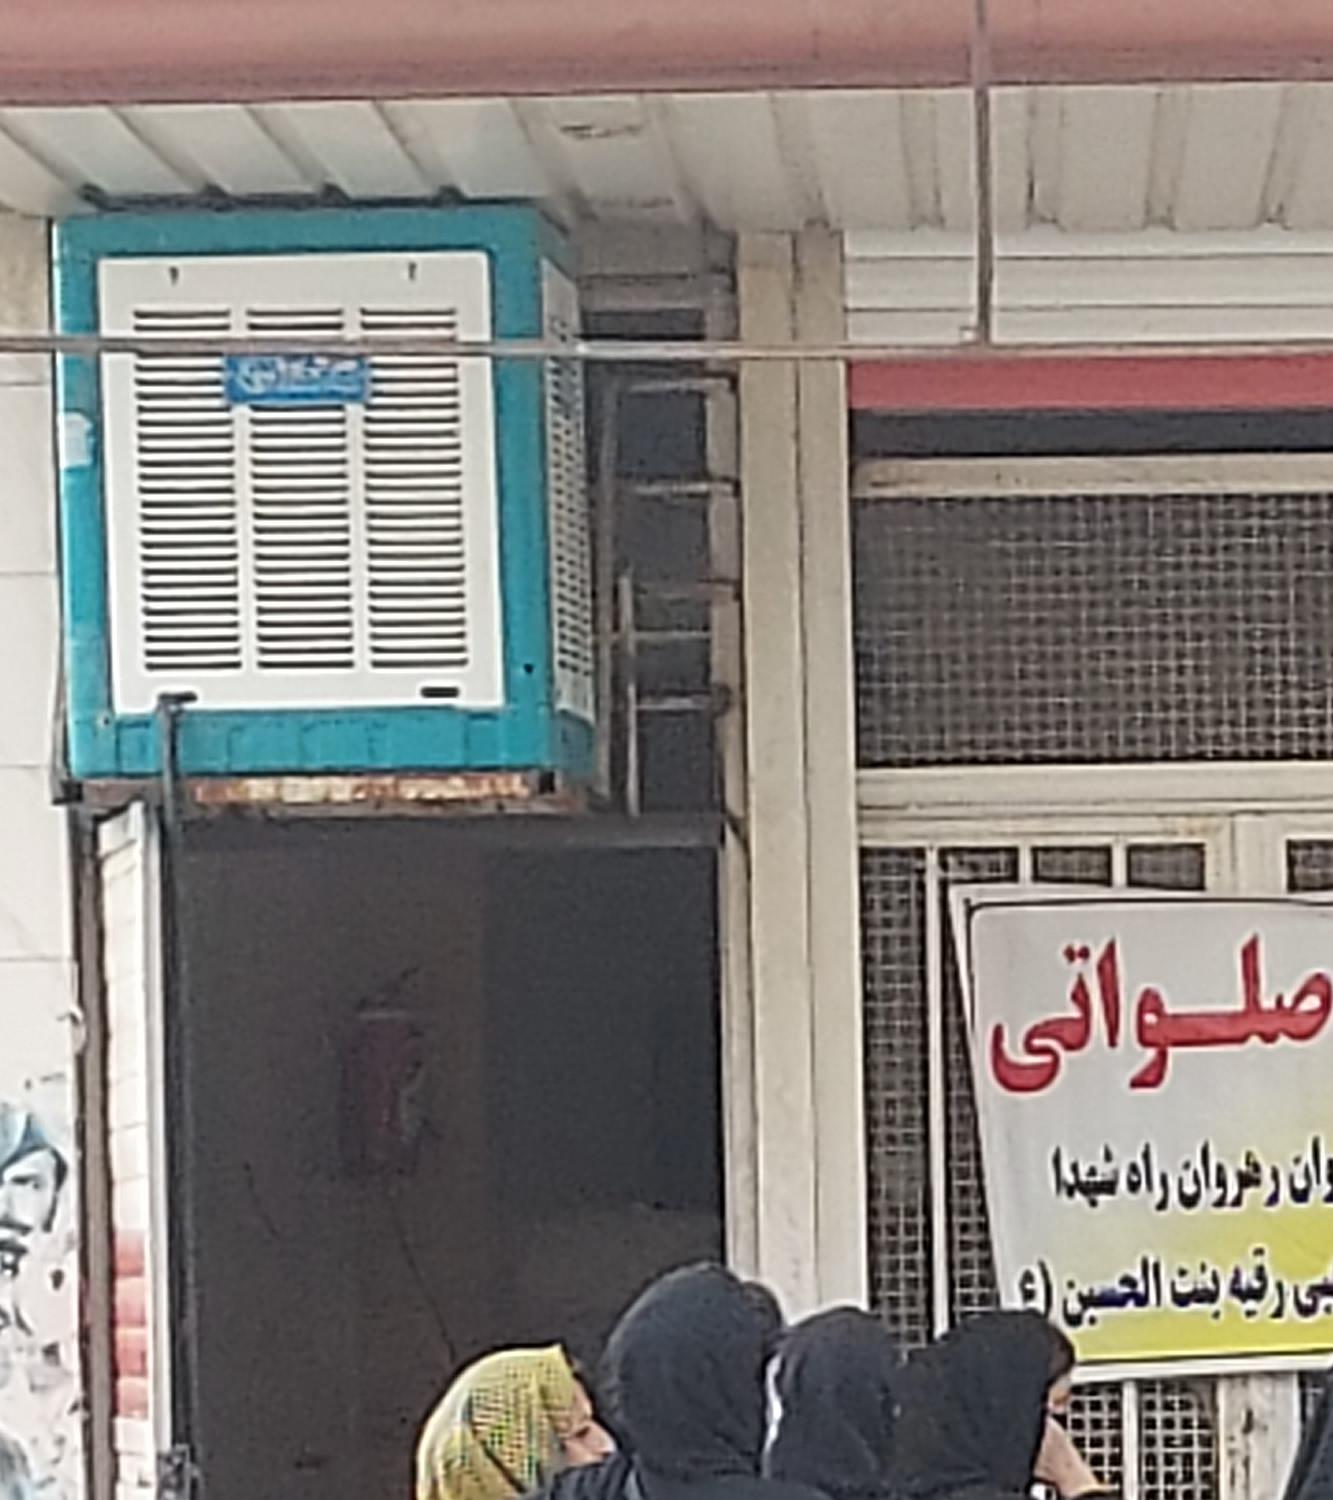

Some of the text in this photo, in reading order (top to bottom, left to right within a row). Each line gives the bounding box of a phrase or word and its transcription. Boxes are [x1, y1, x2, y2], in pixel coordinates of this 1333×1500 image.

[1052, 1143, 1120, 1208] شهدا
[1126, 1141, 1170, 1212] راه
[1177, 1139, 1281, 1209] رهروان
[1061, 1254, 1163, 1327] الحسین
[1170, 1261, 1221, 1320] بنت
[1229, 1246, 1286, 1320] رقیه
